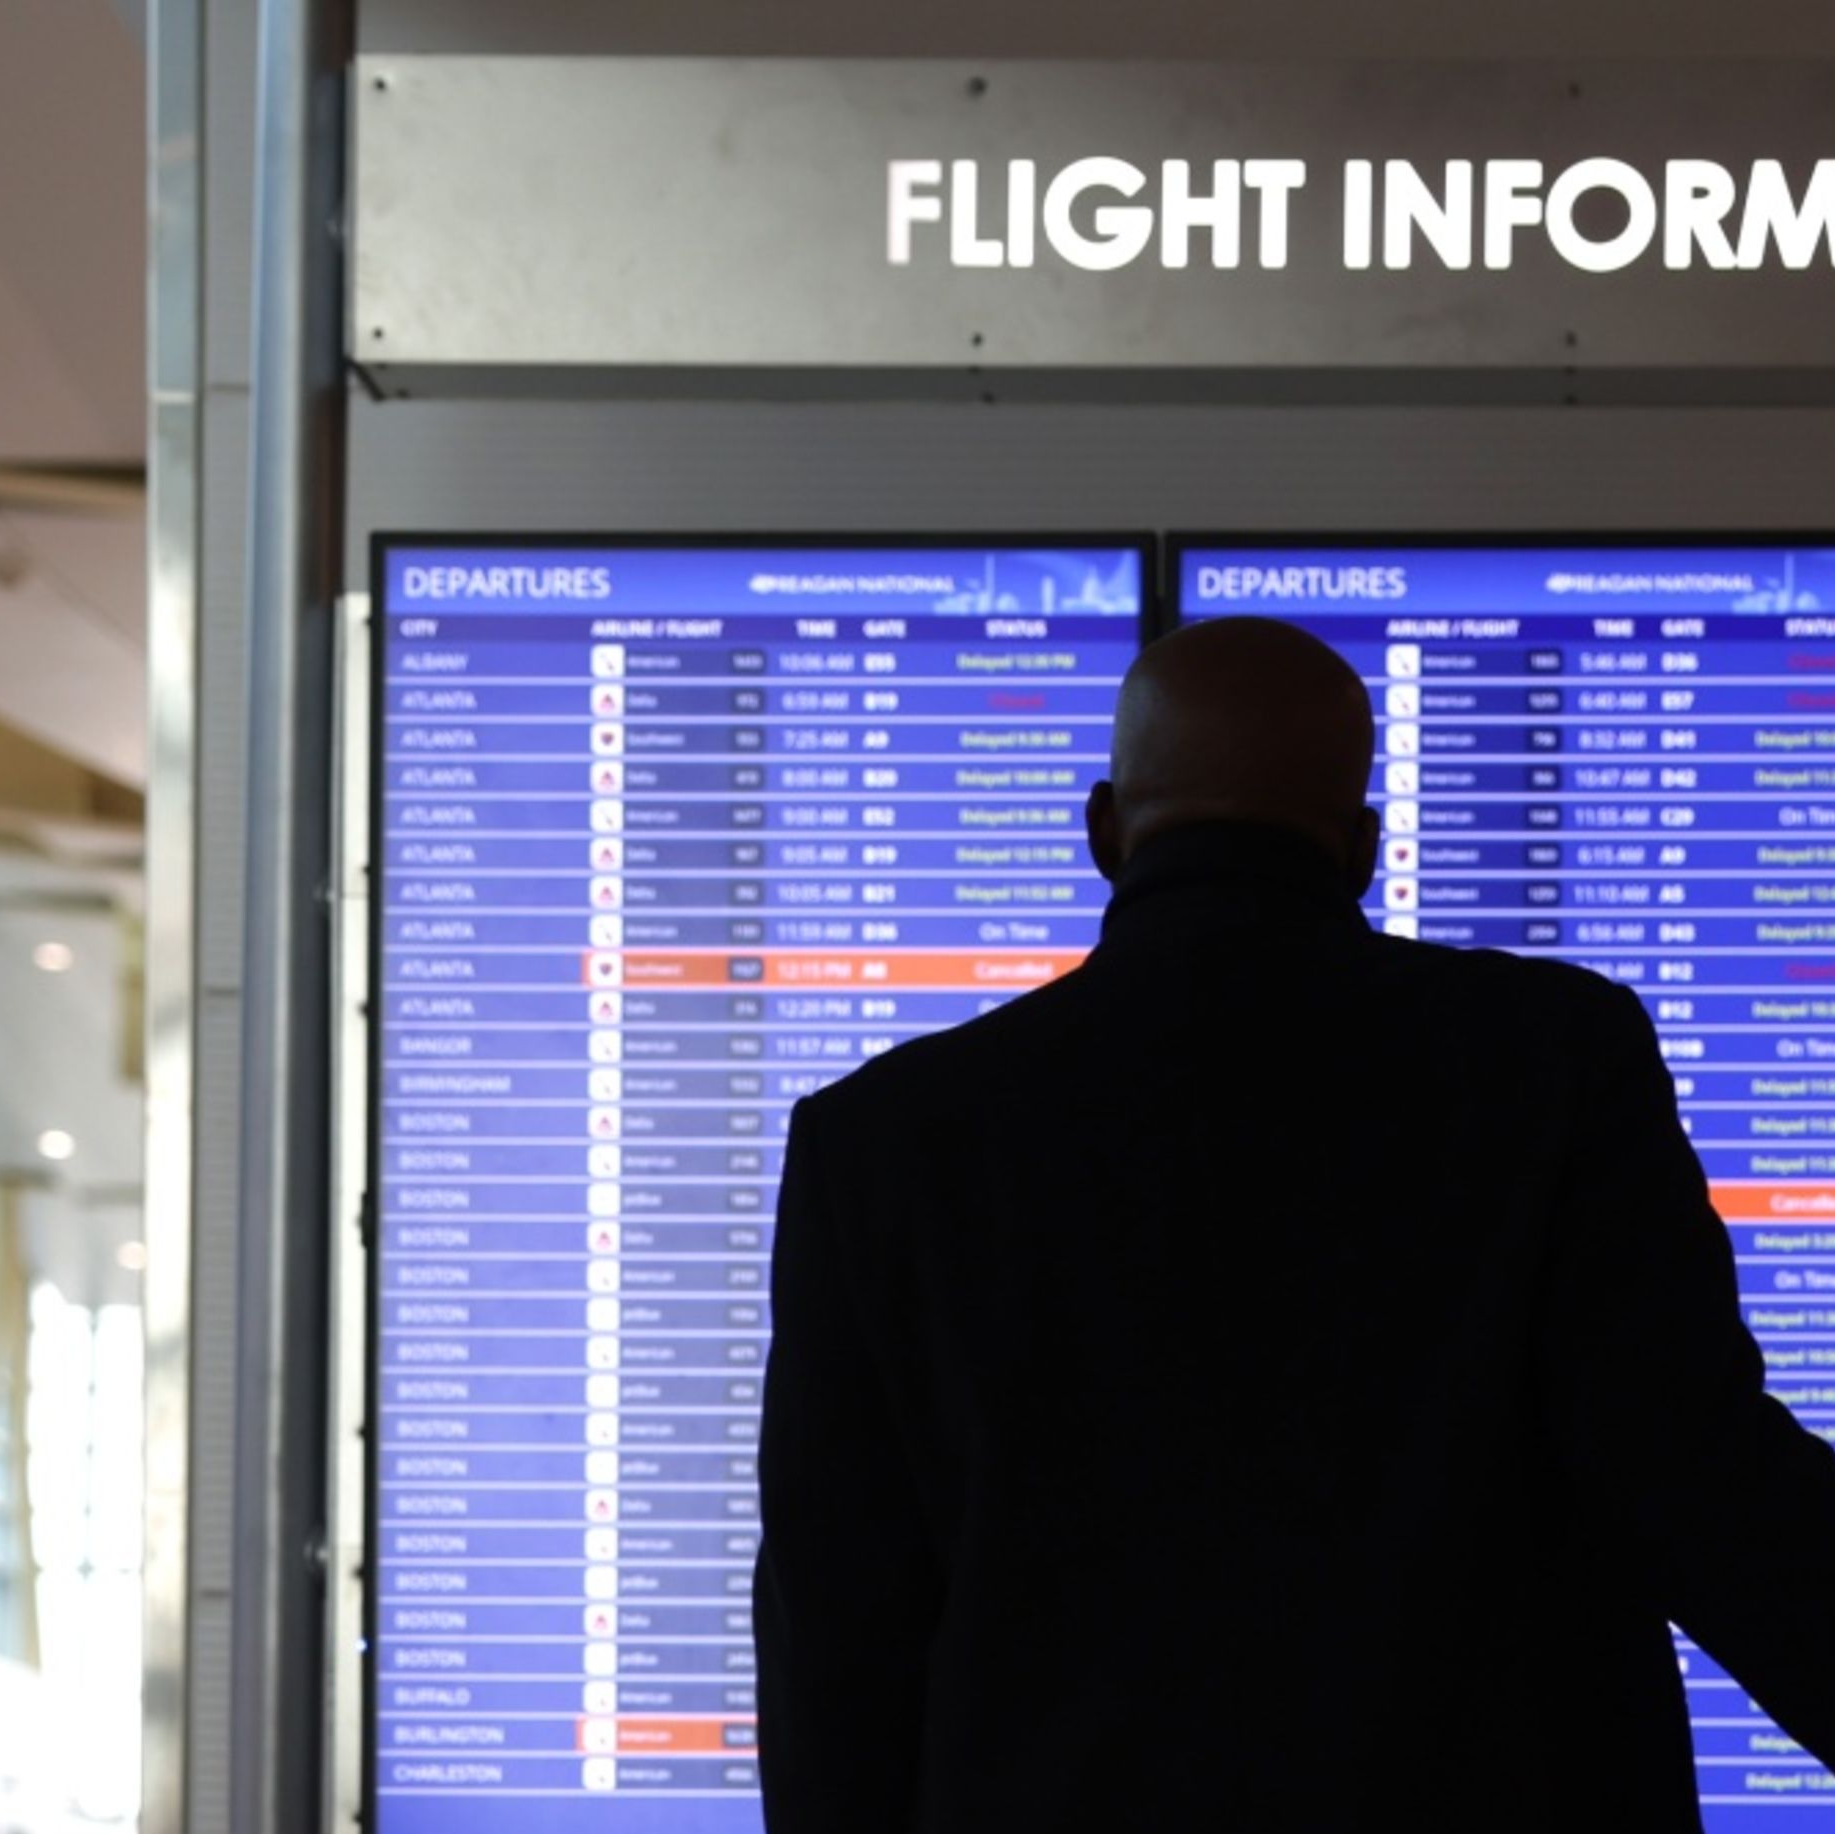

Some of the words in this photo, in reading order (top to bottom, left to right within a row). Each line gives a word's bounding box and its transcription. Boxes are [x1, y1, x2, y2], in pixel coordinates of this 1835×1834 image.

[888, 156, 1306, 271] FLIGHT
[403, 567, 612, 599] DEPARTURES
[771, 575, 855, 594] REAGAN
[857, 575, 956, 594] NATIONAL
[1197, 567, 1408, 599] DEPARTURES
[1571, 573, 1653, 593] REAGAN
[1655, 573, 1753, 593] NATIONAL
[399, 618, 439, 636] CITY
[590, 618, 652, 638] AIRLINE
[666, 618, 724, 638] FLIGHT
[795, 619, 837, 638] TIME
[861, 619, 907, 637] GATE
[984, 619, 1049, 637] STATUS
[1386, 618, 1449, 638] AIRLINE
[1462, 618, 1520, 638] FLIGHT
[1593, 619, 1635, 637] TIME
[1659, 618, 1706, 637] GATE
[400, 652, 468, 671] ALBANY
[400, 690, 478, 710] ATLANTA
[400, 729, 477, 748] ATLANTA
[400, 767, 477, 786] ATLANTA
[399, 806, 477, 824] ATLANTA
[1777, 807, 1808, 826] On
[400, 844, 477, 863] ATLANTA
[400, 882, 477, 901] ATLANTA
[399, 921, 476, 940] ATLANTA
[978, 923, 1008, 941] On
[1007, 922, 1050, 941] Time
[398, 959, 476, 978] ATLANTA
[974, 962, 1054, 979] Cancelled
[399, 998, 476, 1016] ATLANTA
[398, 1037, 473, 1055] BANGOR
[1775, 1039, 1806, 1058] On
[399, 1075, 512, 1093] BIRMINGHAM
[398, 1113, 472, 1132] BOSTON
[397, 1151, 472, 1170] BOSTON
[397, 1189, 471, 1209] BOSTON
[397, 1227, 471, 1246] BOSTON
[396, 1266, 471, 1285] BOSTON
[1773, 1271, 1804, 1289] On
[396, 1304, 471, 1323] BOSTON
[396, 1342, 470, 1361] BOSTON
[395, 1381, 470, 1399] BOSTON
[395, 1419, 470, 1438] BOSTON
[395, 1457, 469, 1476] BOSTON
[395, 1495, 469, 1514] BOSTON
[394, 1534, 468, 1552] BOSTON
[394, 1572, 468, 1591] BOSTON
[394, 1610, 468, 1629] BOSTON
[394, 1649, 468, 1667] BOSTON
[393, 1687, 472, 1706] BUFFALO
[393, 1725, 506, 1743] BURLINGTON
[393, 1764, 504, 1782] CHARLESTON
